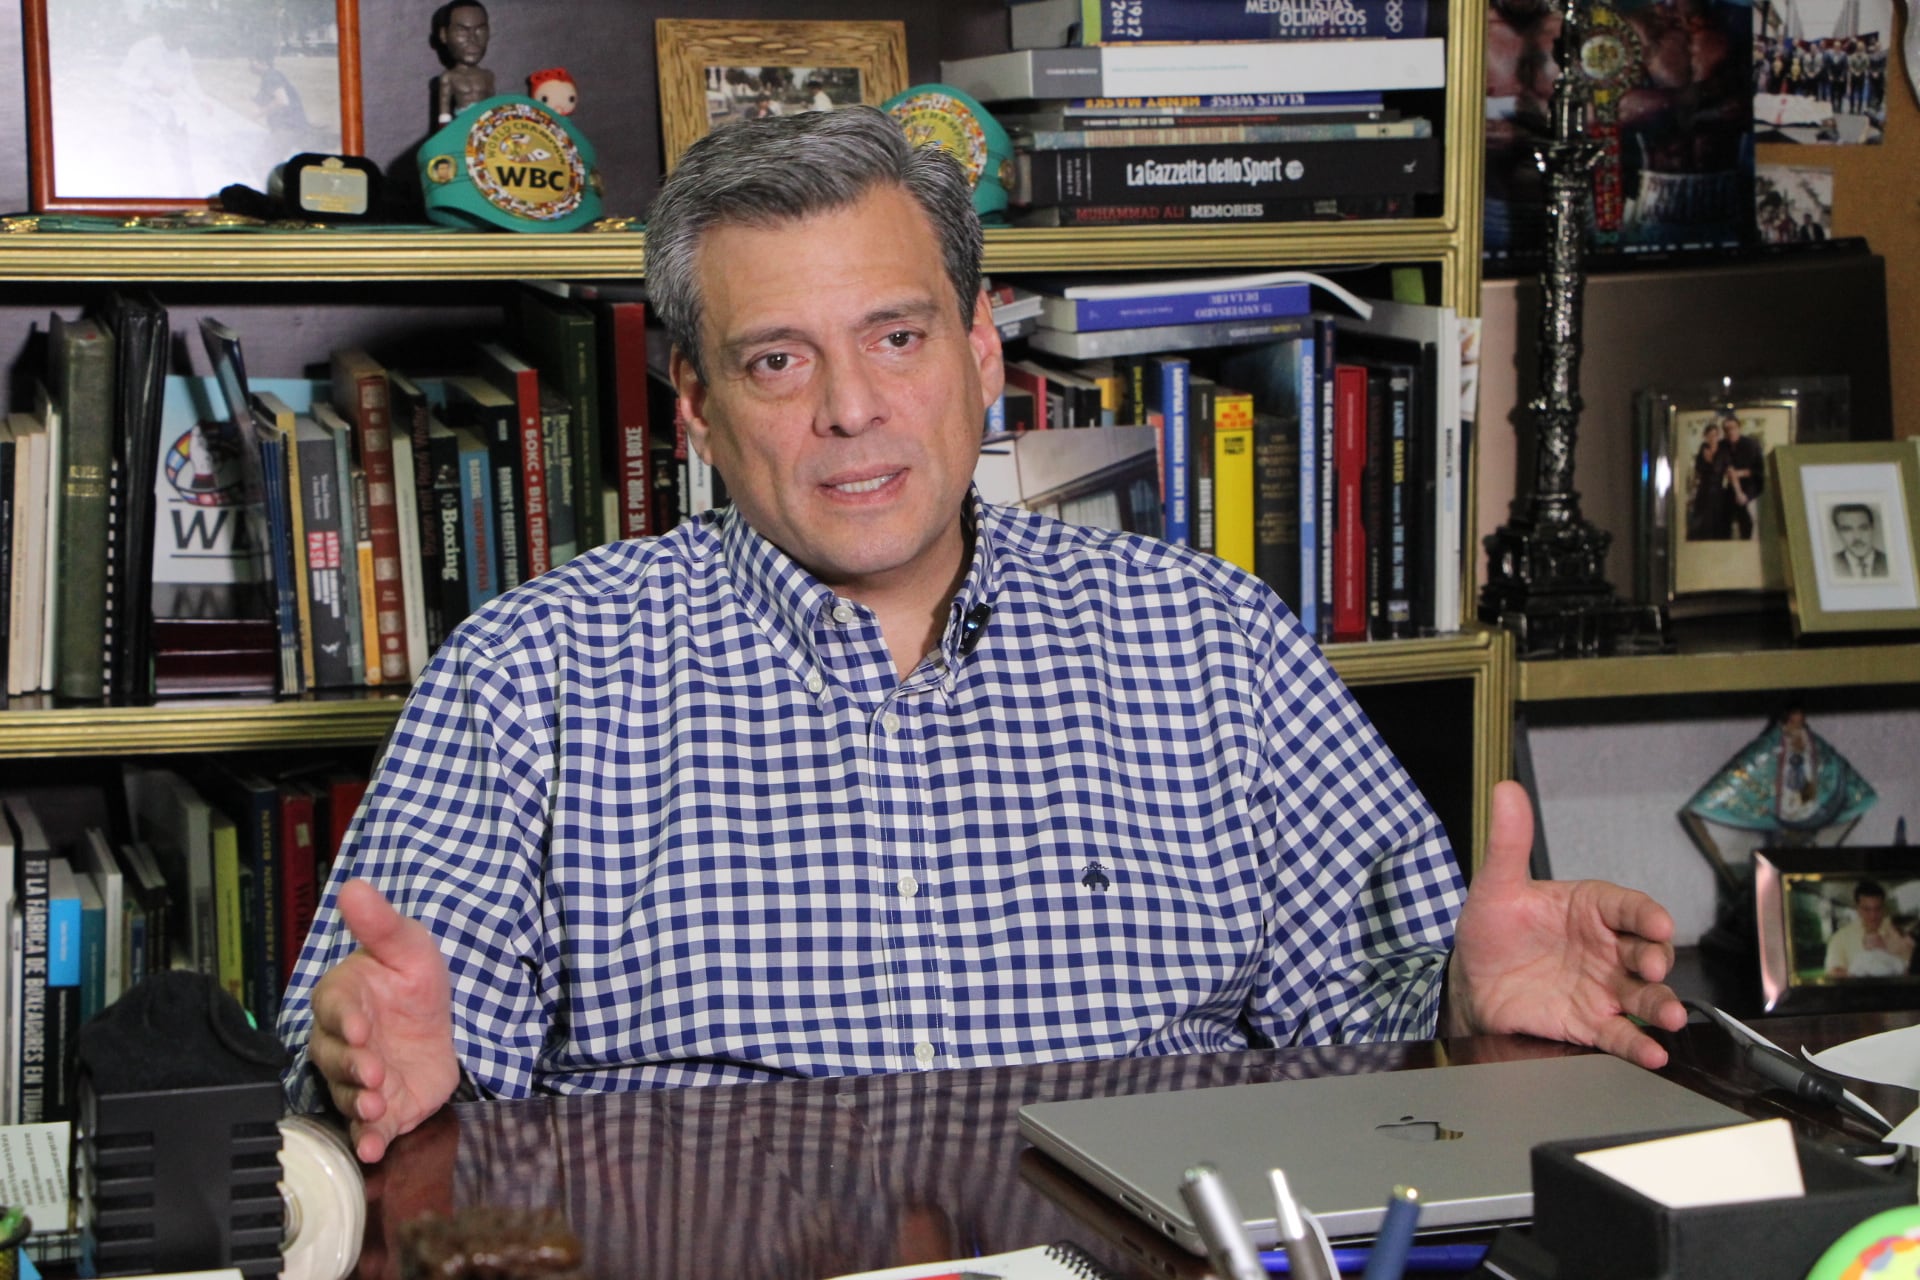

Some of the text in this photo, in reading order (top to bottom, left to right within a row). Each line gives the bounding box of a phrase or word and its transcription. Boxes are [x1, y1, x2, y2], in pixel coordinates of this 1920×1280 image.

[1245, 0, 1354, 13] MEDALLISTAS
[1084, 98, 1142, 109] MASKE
[1146, 97, 1201, 108] HENRY
[1257, 93, 1305, 106] KLAUS
[495, 166, 565, 191] WBC
[1076, 203, 1264, 221] MUHAMMAD ALI MEMORIES
[1194, 304, 1260, 318] ANIVERSARIO
[1228, 293, 1244, 303] LA
[1246, 291, 1260, 302] DE
[1172, 367, 1185, 523] ICH LEBE MEINEN TRAUM
[1302, 355, 1314, 524] GOLDEN GLOVES OF UKRAINE
[1393, 439, 1404, 483] SHAVERS
[625, 425, 646, 533] VIE POUR LA BOXE
[1322, 381, 1333, 604] THE ONE-TWO PUNCH BOXING WORKOUT
[525, 429, 547, 577] БОКС ВІД ПЕРШО
[441, 508, 461, 581] Boxing
[502, 511, 517, 557] GREATEST
[309, 532, 326, 568] PASO
[261, 810, 272, 860] BOXEN
[25, 878, 47, 896] LA
[263, 865, 276, 961] FASZINATION
[24, 957, 47, 974] DE
[24, 977, 47, 1064] BOXEADORES
[24, 1066, 44, 1084] EN
